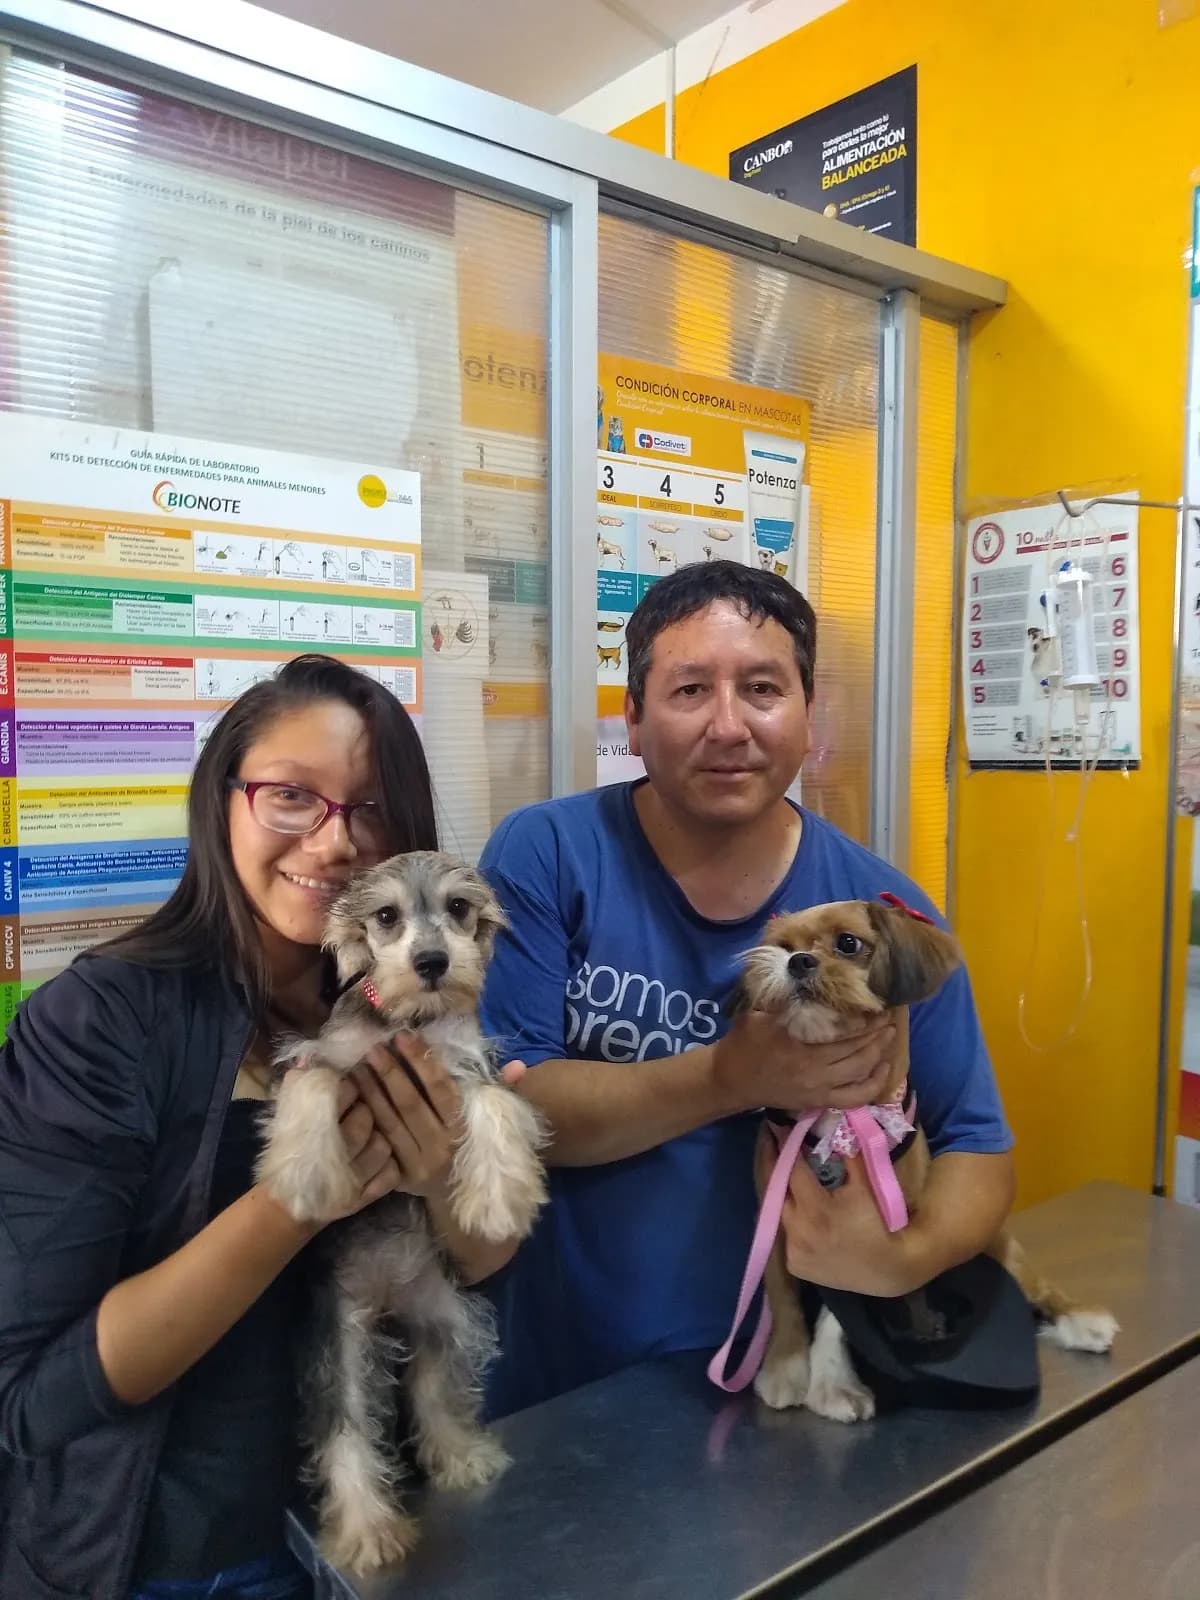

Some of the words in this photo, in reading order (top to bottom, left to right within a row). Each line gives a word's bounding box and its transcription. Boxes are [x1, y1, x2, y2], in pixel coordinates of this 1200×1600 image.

[822, 144, 907, 190] BALANCEADA
[823, 127, 905, 174] ALIMENTACIÓN
[459, 351, 548, 395] oten
[616, 375, 679, 399] CONDICIÓN
[682, 390, 736, 412] CORPORAL
[739, 402, 752, 414] EN
[754, 405, 801, 426] MASCOTAS
[654, 437, 686, 450] Codivet
[50, 452, 70, 462] KITS
[72, 455, 85, 464] DE
[87, 457, 137, 472] DETECCIÓN
[140, 464, 151, 473] DE
[154, 465, 222, 482] ENFERMEDADES
[223, 475, 245, 485] PARA
[247, 478, 287, 491] ANIMALES
[288, 483, 326, 496] MENORES
[130, 449, 152, 460] GUÍA
[155, 452, 187, 465] RÁPIDA
[189, 458, 200, 466] DE
[202, 460, 260, 475] LABORATORIO
[603, 466, 614, 488] 3
[660, 475, 672, 497] 4
[714, 484, 725, 504] 5
[749, 468, 796, 490] Potenza
[168, 492, 241, 514] BIONOTE
[1016, 532, 1033, 546] 10
[972, 576, 979, 594] 1
[1111, 557, 1126, 576] 6
[970, 604, 982, 622] 2
[1112, 588, 1126, 607] 7
[971, 631, 982, 649] 3
[1112, 618, 1127, 638] 8
[971, 658, 986, 676] 4
[1112, 649, 1127, 668] 9
[974, 686, 986, 705] 5
[1102, 679, 1127, 699] 10
[1, 721, 10, 765] GIARDIA
[4, 860, 12, 868] 4
[4, 869, 13, 901] CANIV
[566, 961, 719, 1038] somos
